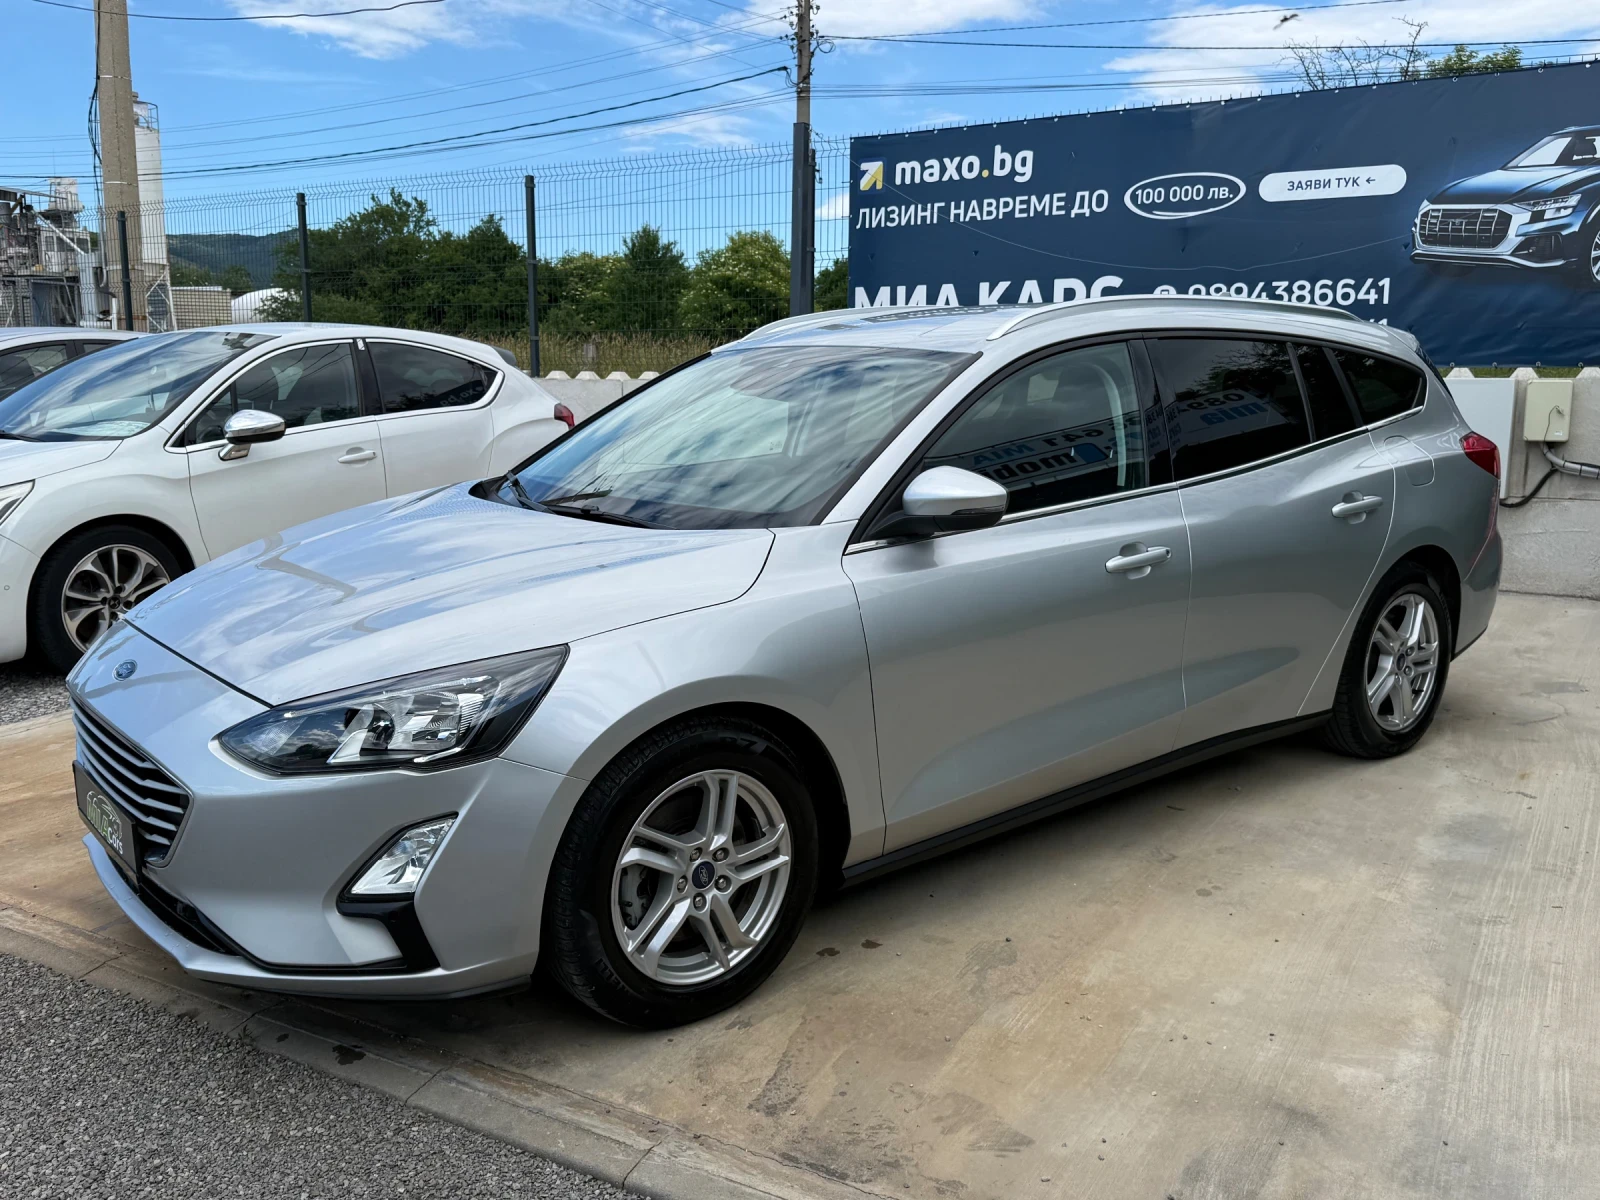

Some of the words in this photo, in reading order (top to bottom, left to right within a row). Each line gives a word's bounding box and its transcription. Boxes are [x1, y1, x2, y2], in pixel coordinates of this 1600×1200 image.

[895, 144, 1034, 185] maxo.bg
[1135, 187, 1165, 205] 100
[1169, 184, 1204, 202] 000
[1207, 186, 1234, 200] лв.
[1287, 179, 1331, 191] ЗАЯВИ
[1335, 176, 1361, 188] ТУК
[856, 202, 946, 229] ЛИЗИНГ
[950, 192, 1067, 223] НАВРЕМЕ
[1071, 189, 1109, 218] ДО
